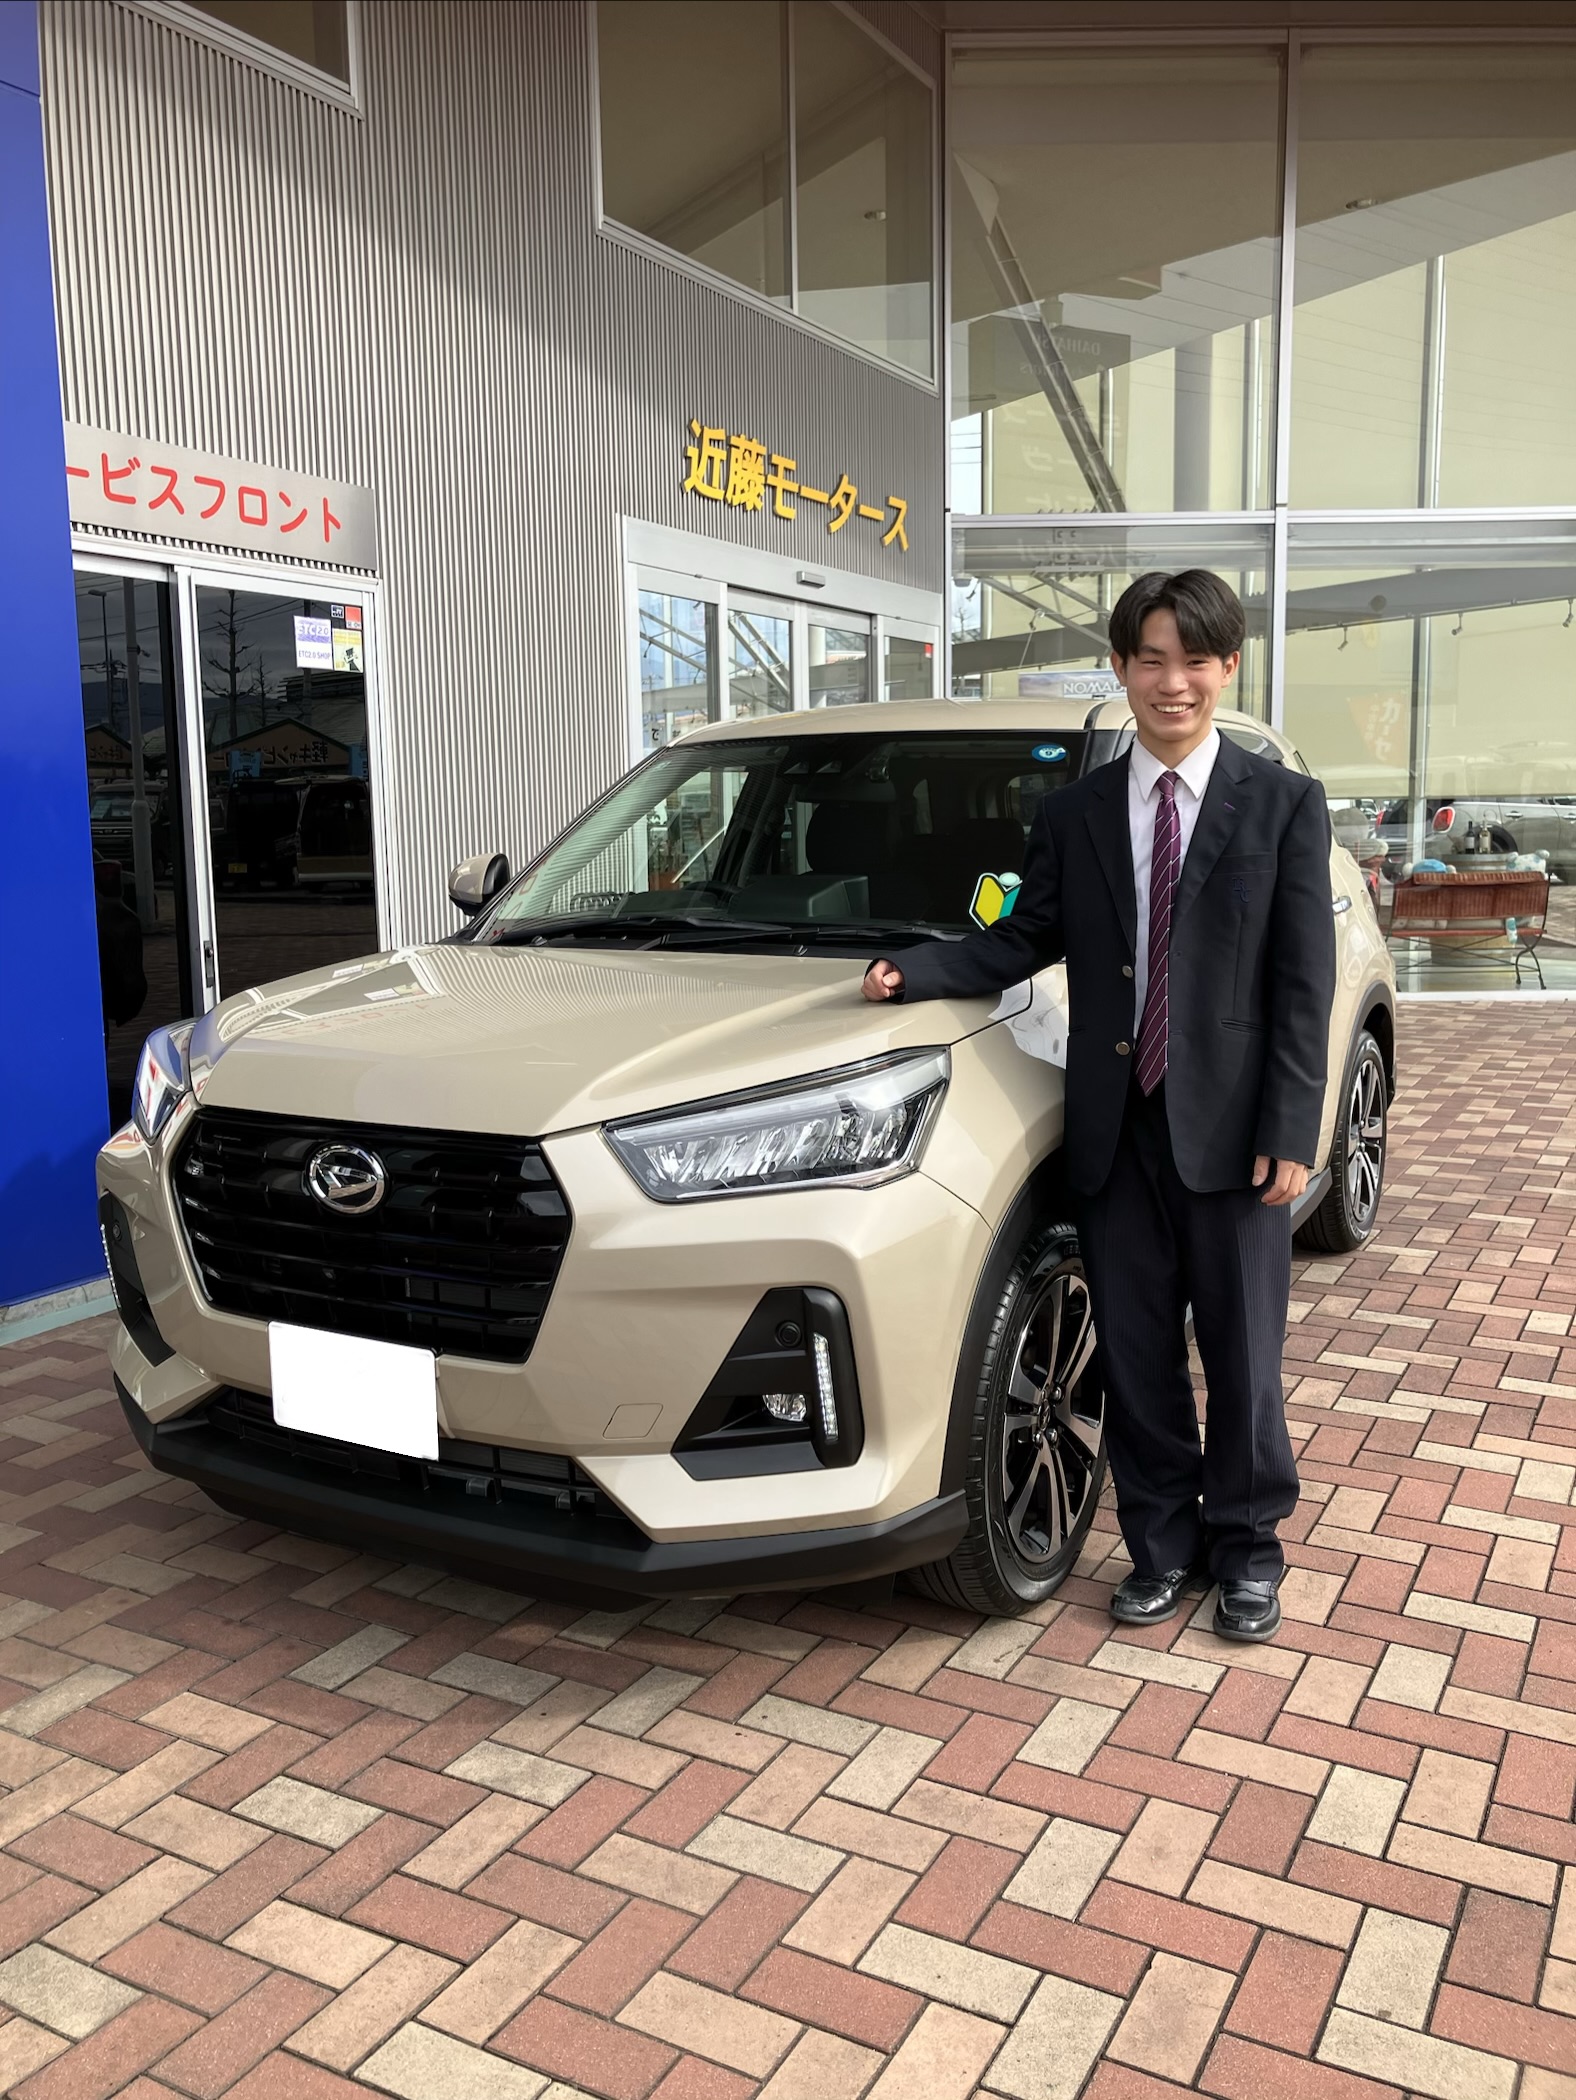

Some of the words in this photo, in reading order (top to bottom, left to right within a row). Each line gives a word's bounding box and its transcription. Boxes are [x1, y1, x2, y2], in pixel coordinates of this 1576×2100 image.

[683, 418, 910, 552] 近藤モータース
[298, 649, 316, 658] ETC2.0
[317, 651, 331, 660] SHOP
